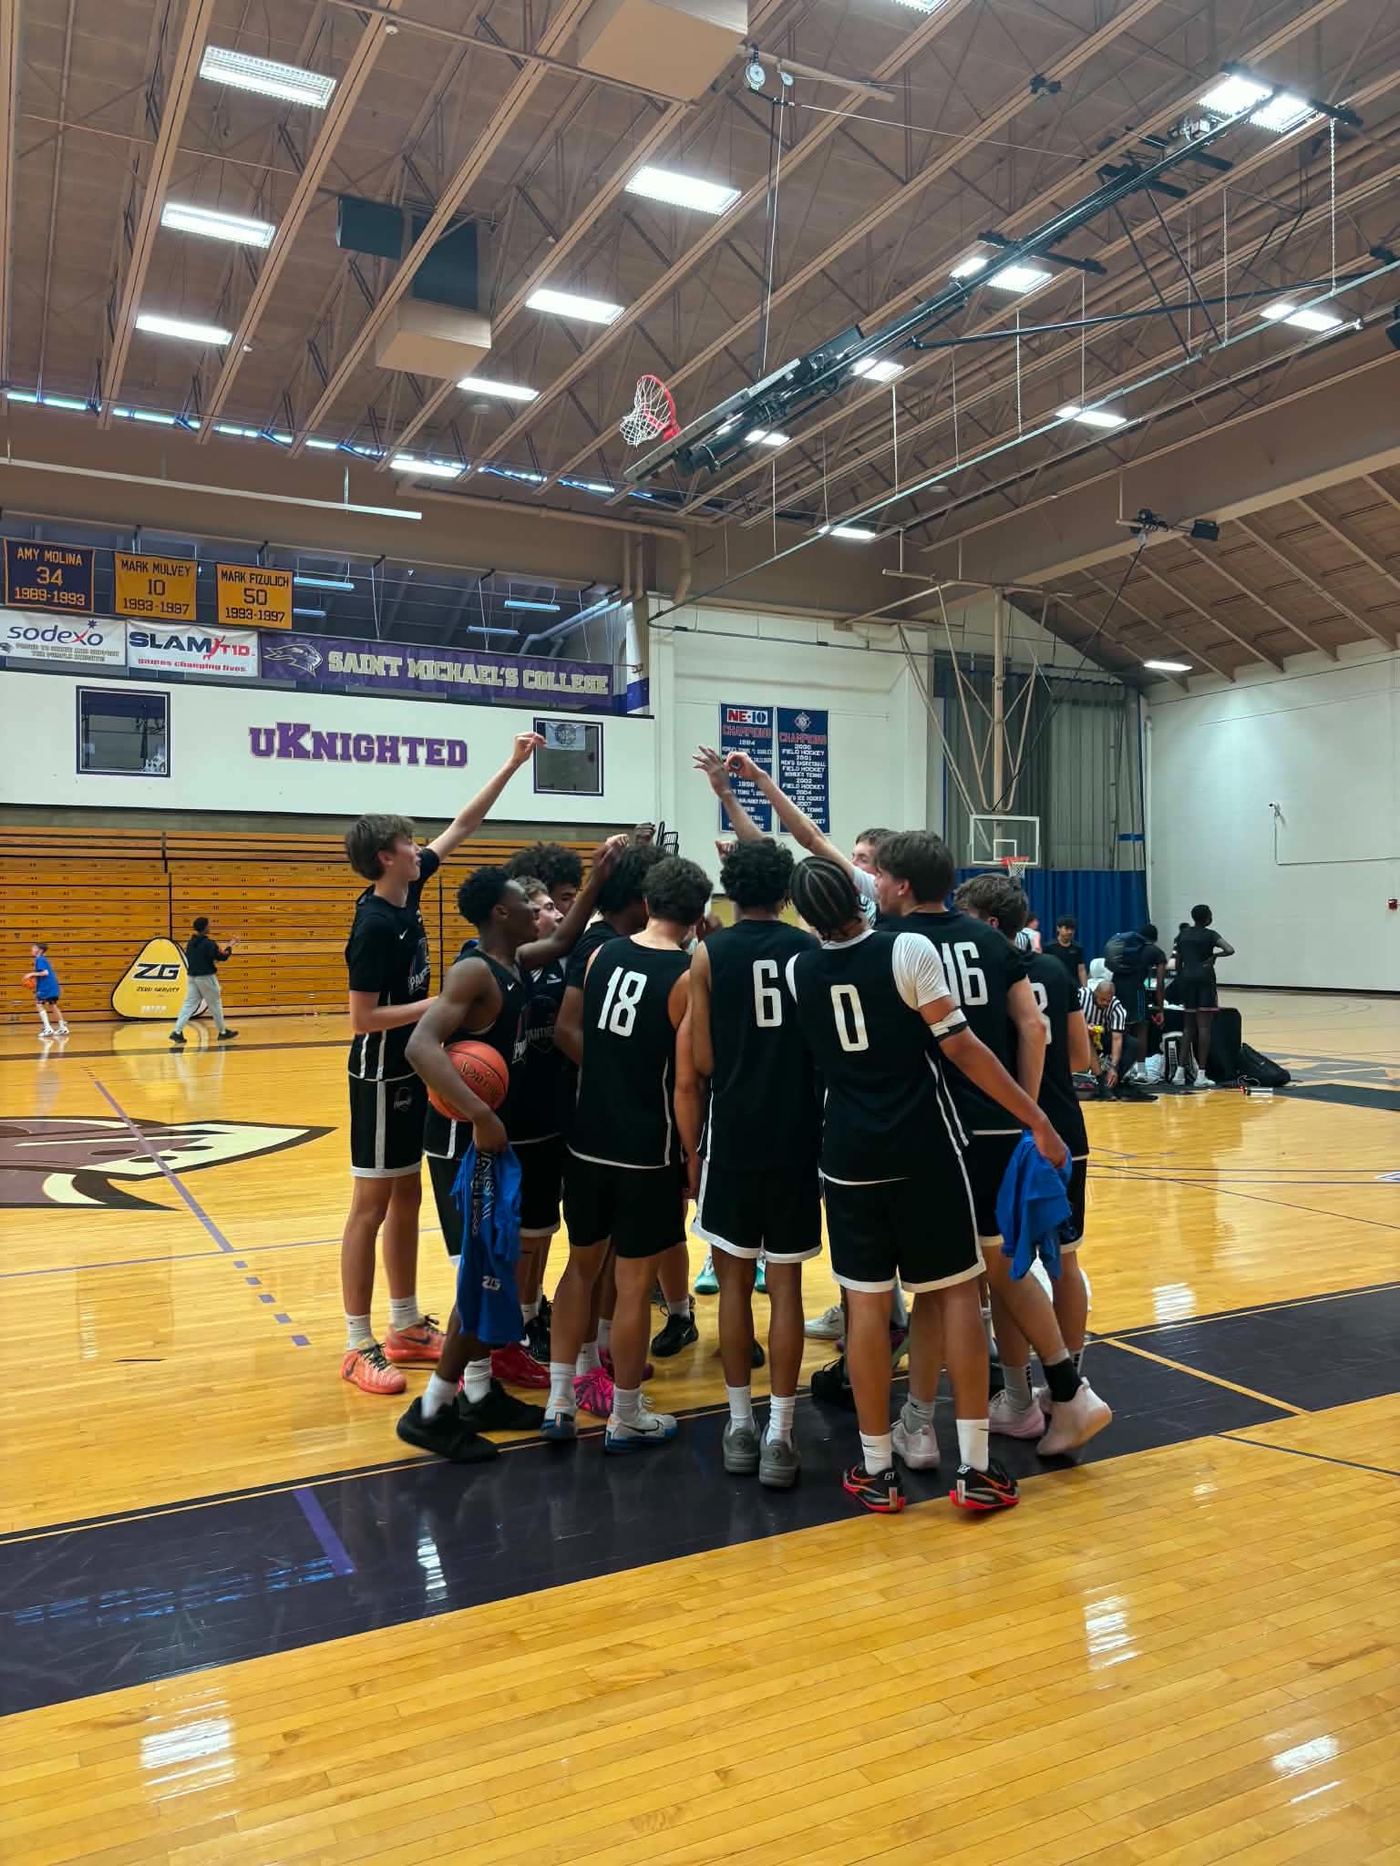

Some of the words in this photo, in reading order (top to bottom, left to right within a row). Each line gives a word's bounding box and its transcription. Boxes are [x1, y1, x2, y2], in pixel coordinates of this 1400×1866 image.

[17, 547, 40, 560] AMY
[45, 551, 82, 566] MOLINA
[36, 566, 64, 587] 34
[121, 559, 149, 572] MARK
[153, 562, 192, 577] MULVEY
[220, 570, 247, 583] MARK
[15, 587, 85, 606] 1989-1993
[148, 579, 166, 596] 10
[244, 588, 267, 606] 50
[123, 597, 190, 615] 1993-1997
[225, 607, 286, 623] 1993-1997
[7, 624, 104, 646] sodexo
[129, 631, 212, 653] SLAM
[328, 651, 402, 677] SAINT
[407, 658, 519, 688] MICHAEL'S
[523, 669, 609, 695] COLLEGE
[133, 963, 181, 980] ZG
[941, 941, 989, 1006] 16
[597, 966, 648, 1037] 18
[752, 959, 783, 1028] 6
[830, 983, 869, 1053] 0
